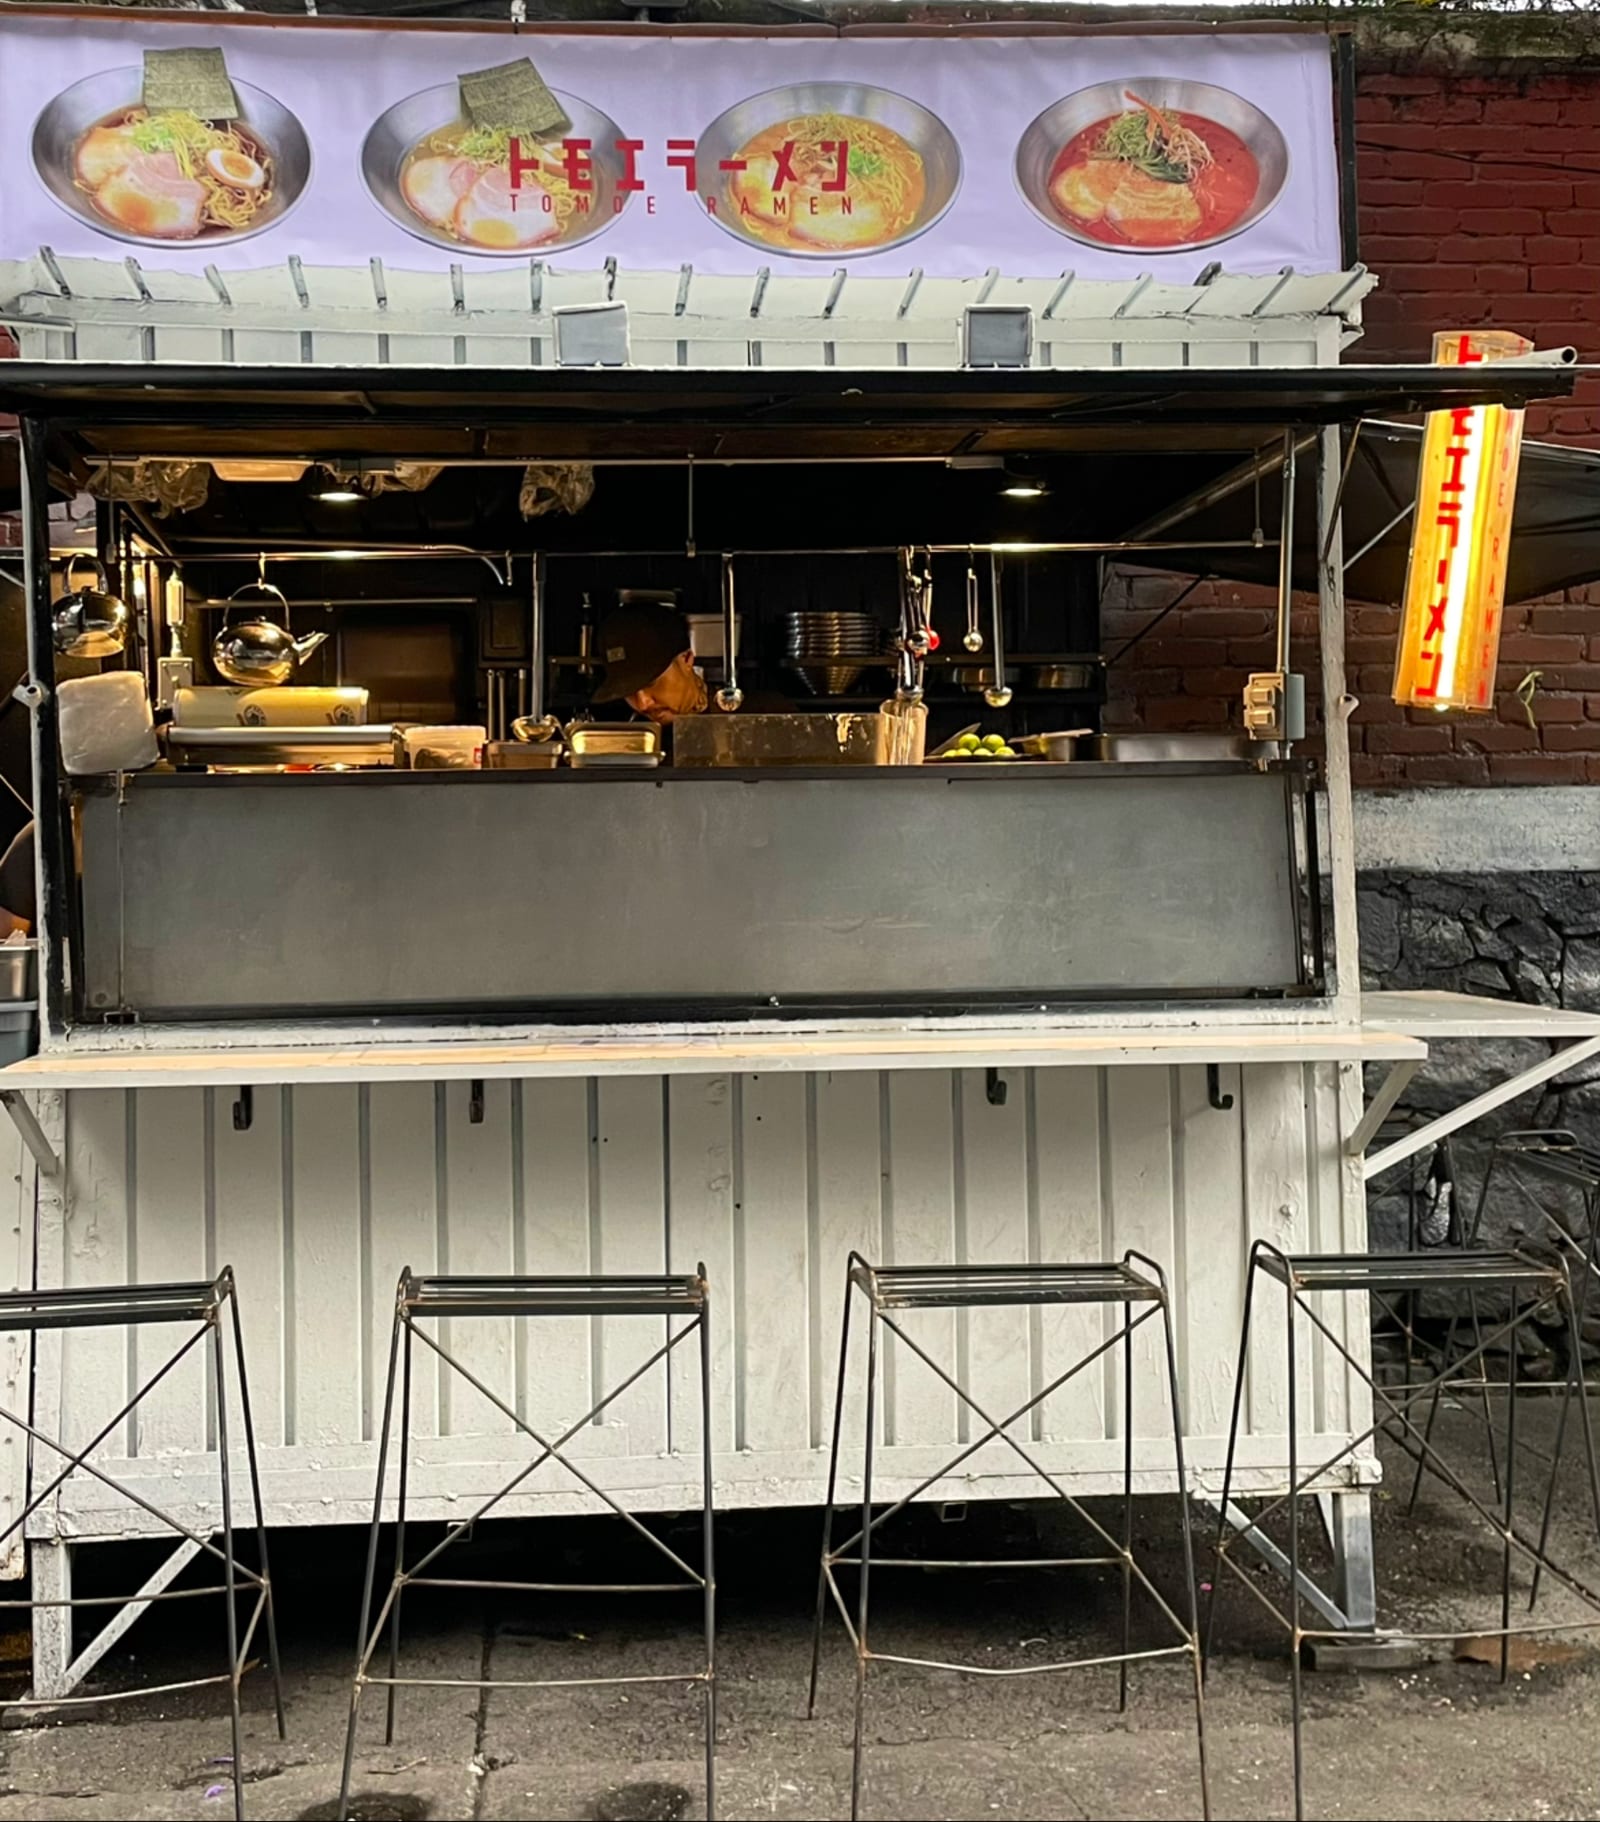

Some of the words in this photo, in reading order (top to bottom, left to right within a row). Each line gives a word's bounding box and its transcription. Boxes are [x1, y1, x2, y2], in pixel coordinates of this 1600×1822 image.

[509, 137, 849, 191] トモエラーメン
[509, 194, 656, 214] TOMOE
[706, 196, 852, 215] RAMEN
